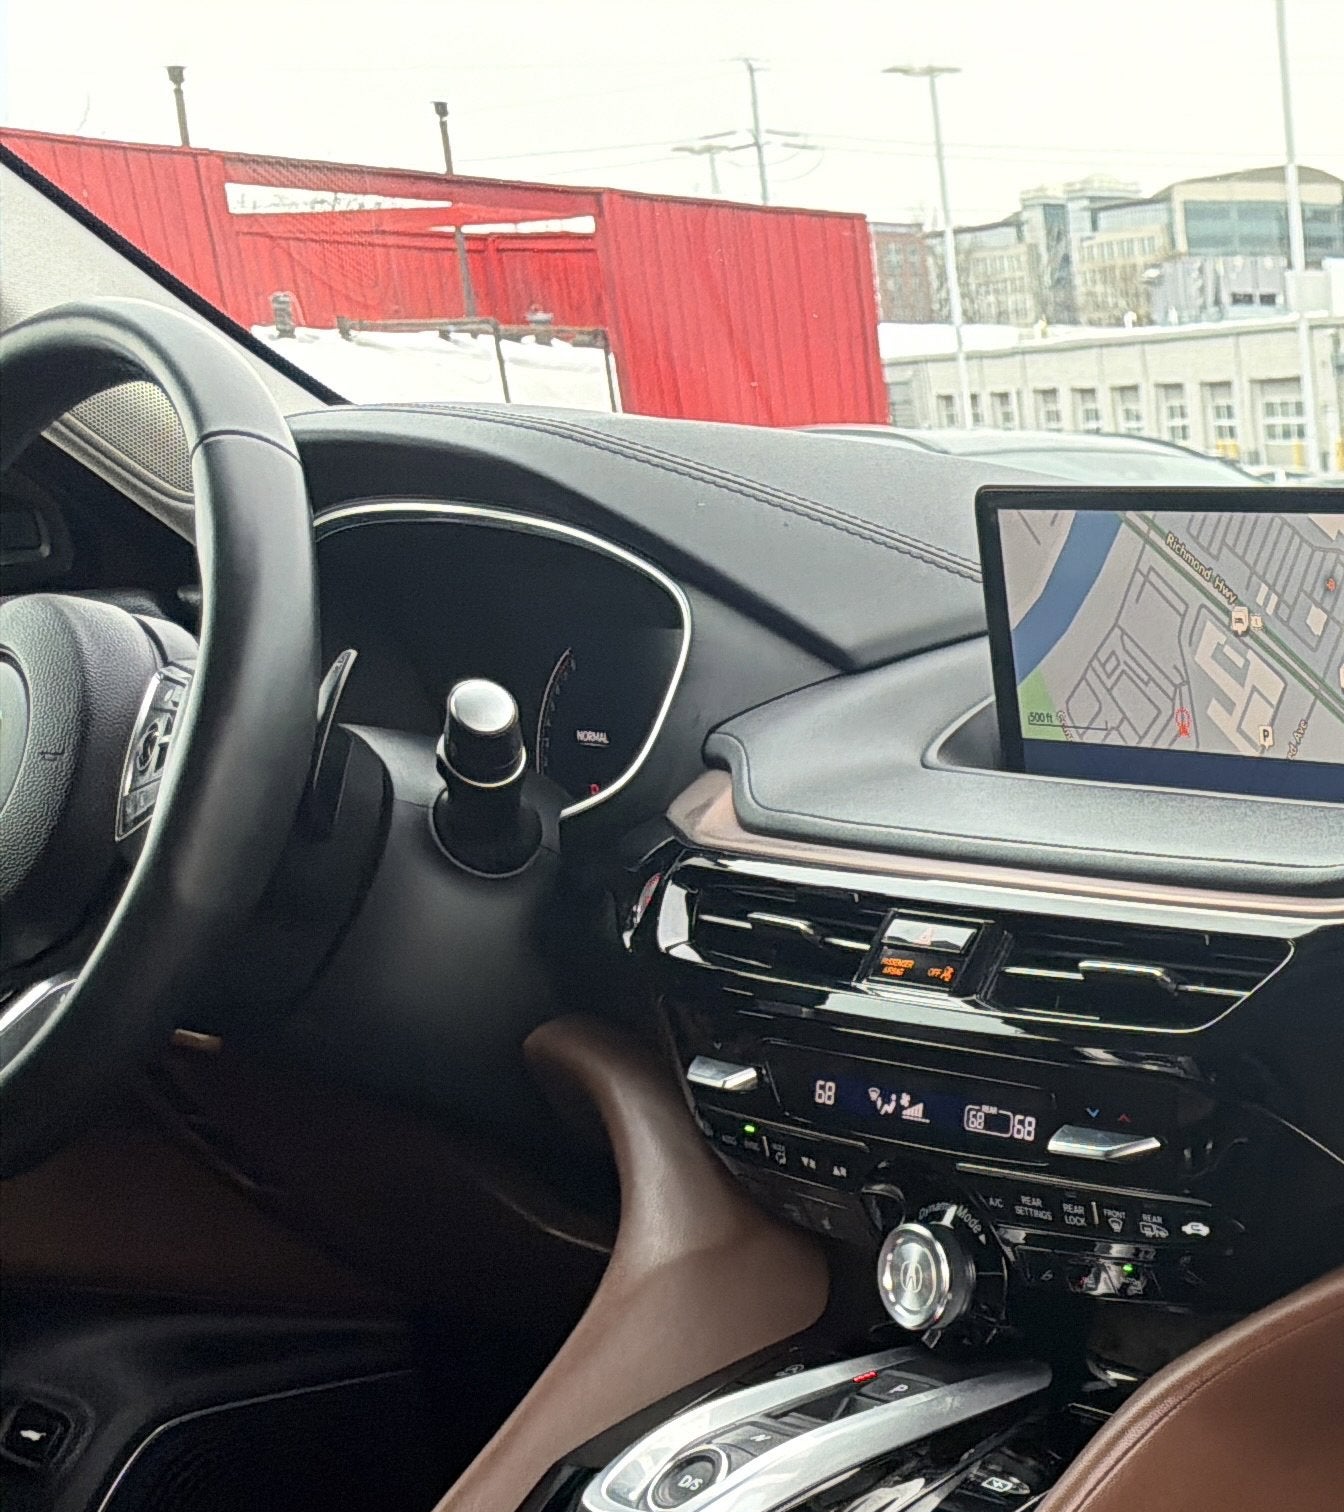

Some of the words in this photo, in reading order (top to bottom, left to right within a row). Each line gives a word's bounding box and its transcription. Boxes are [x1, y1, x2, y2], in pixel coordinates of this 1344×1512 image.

[1166, 531, 1213, 581] Richmond
[1214, 573, 1238, 604] Hwy
[1029, 711, 1045, 723] 500
[1046, 712, 1054, 724] ft
[576, 729, 610, 744] NORMAL
[814, 1079, 836, 1105] 68
[968, 1110, 985, 1130] 68
[1013, 1114, 1036, 1141] 68
[1020, 1195, 1043, 1208] REAR
[1062, 1202, 1085, 1214] REAR
[957, 1204, 982, 1234] Mode
[1014, 1205, 1053, 1221] SETTINGS
[1064, 1214, 1087, 1227] LOCK
[1103, 1208, 1126, 1219] FRONT
[1141, 1213, 1163, 1224] REAR
[889, 1383, 909, 1395] P
[677, 1475, 704, 1491] D/S
